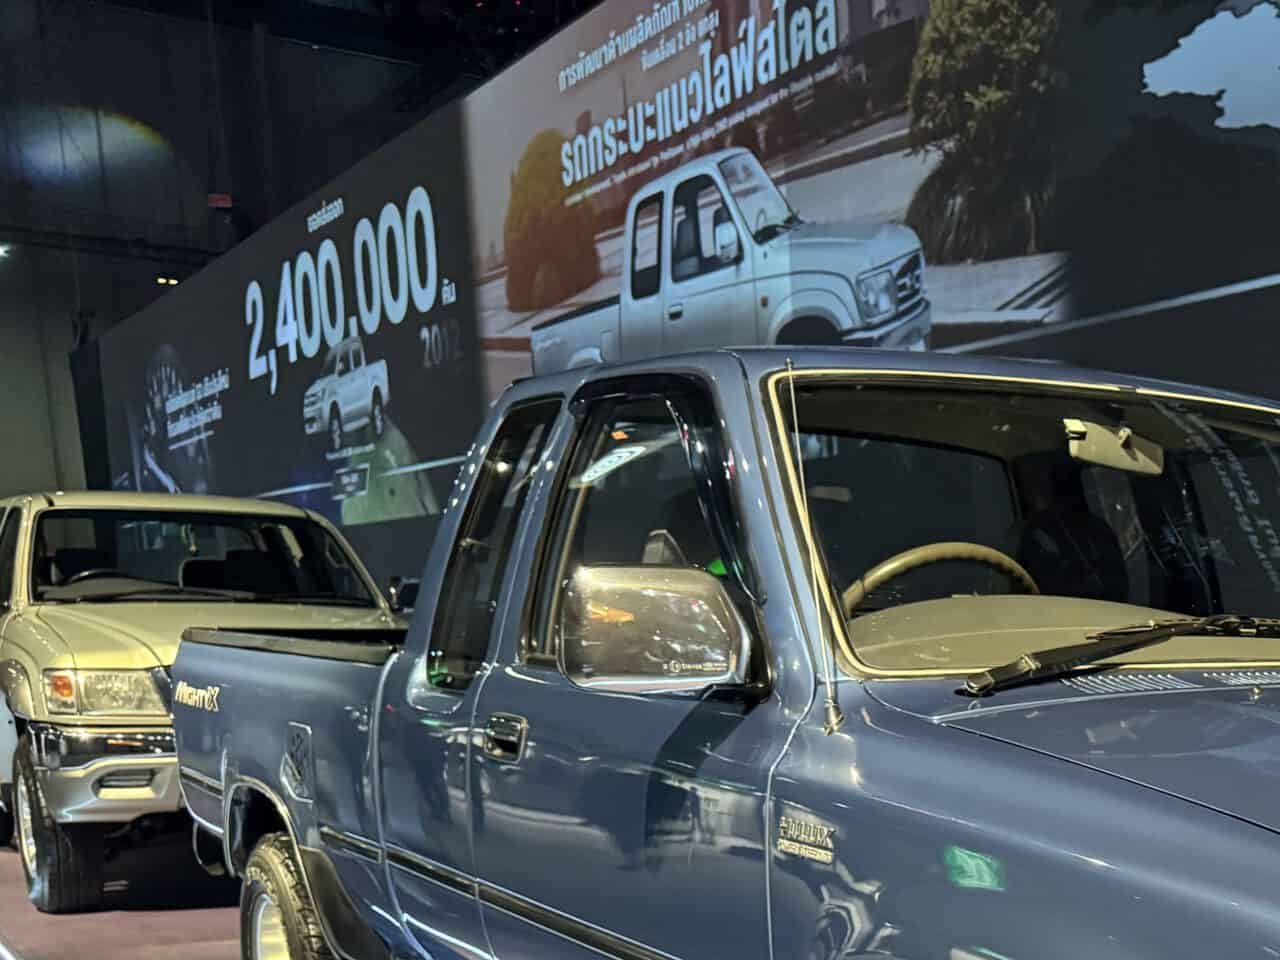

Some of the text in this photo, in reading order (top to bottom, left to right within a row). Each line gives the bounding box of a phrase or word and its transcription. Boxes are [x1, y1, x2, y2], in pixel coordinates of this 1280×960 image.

[560, 0, 838, 188] รถกระบะแนวไลฟ์สไตล
[245, 186, 438, 395] 2,400,000
